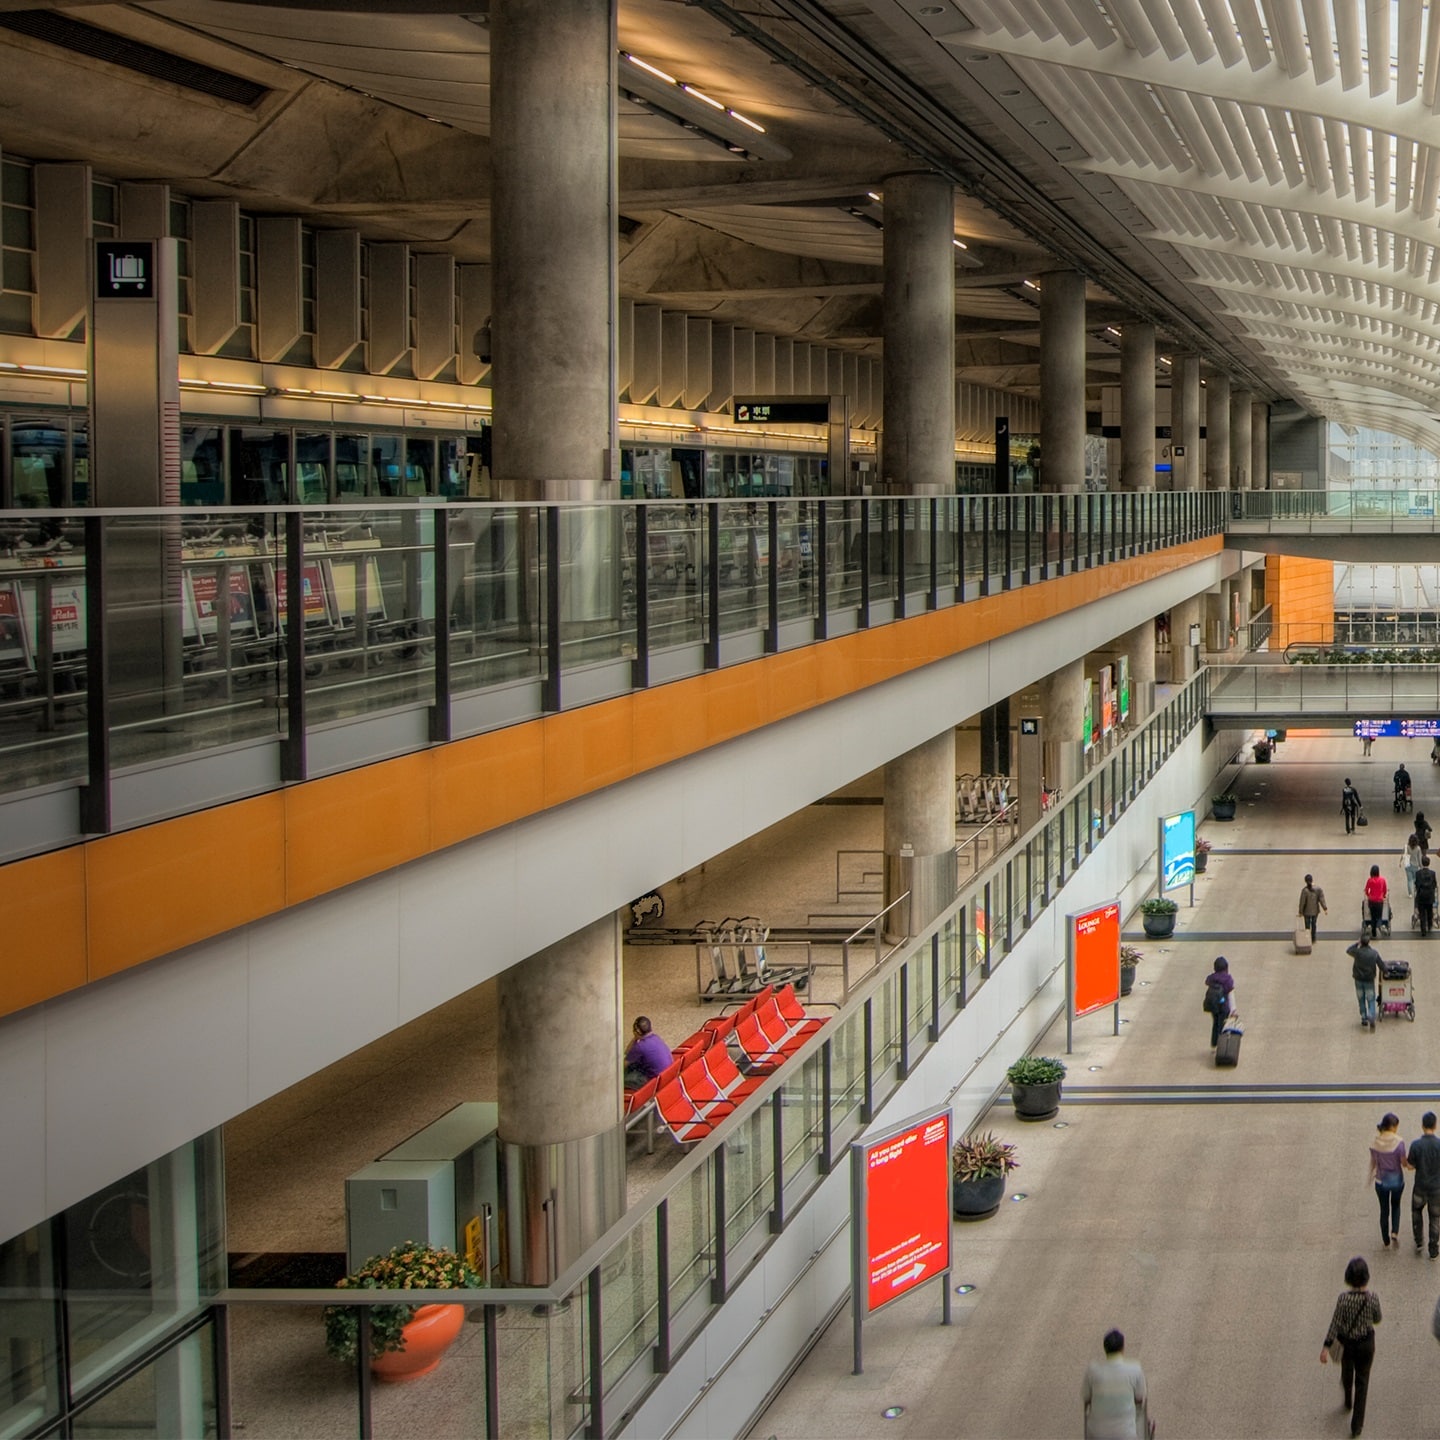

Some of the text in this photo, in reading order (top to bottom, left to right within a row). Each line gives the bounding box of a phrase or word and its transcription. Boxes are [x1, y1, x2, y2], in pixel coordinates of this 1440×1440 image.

[870, 1151, 878, 1160] All
[879, 1147, 890, 1158] you
[890, 1139, 905, 1151] need
[876, 1156, 889, 1166] long
[889, 1147, 903, 1160] flight
